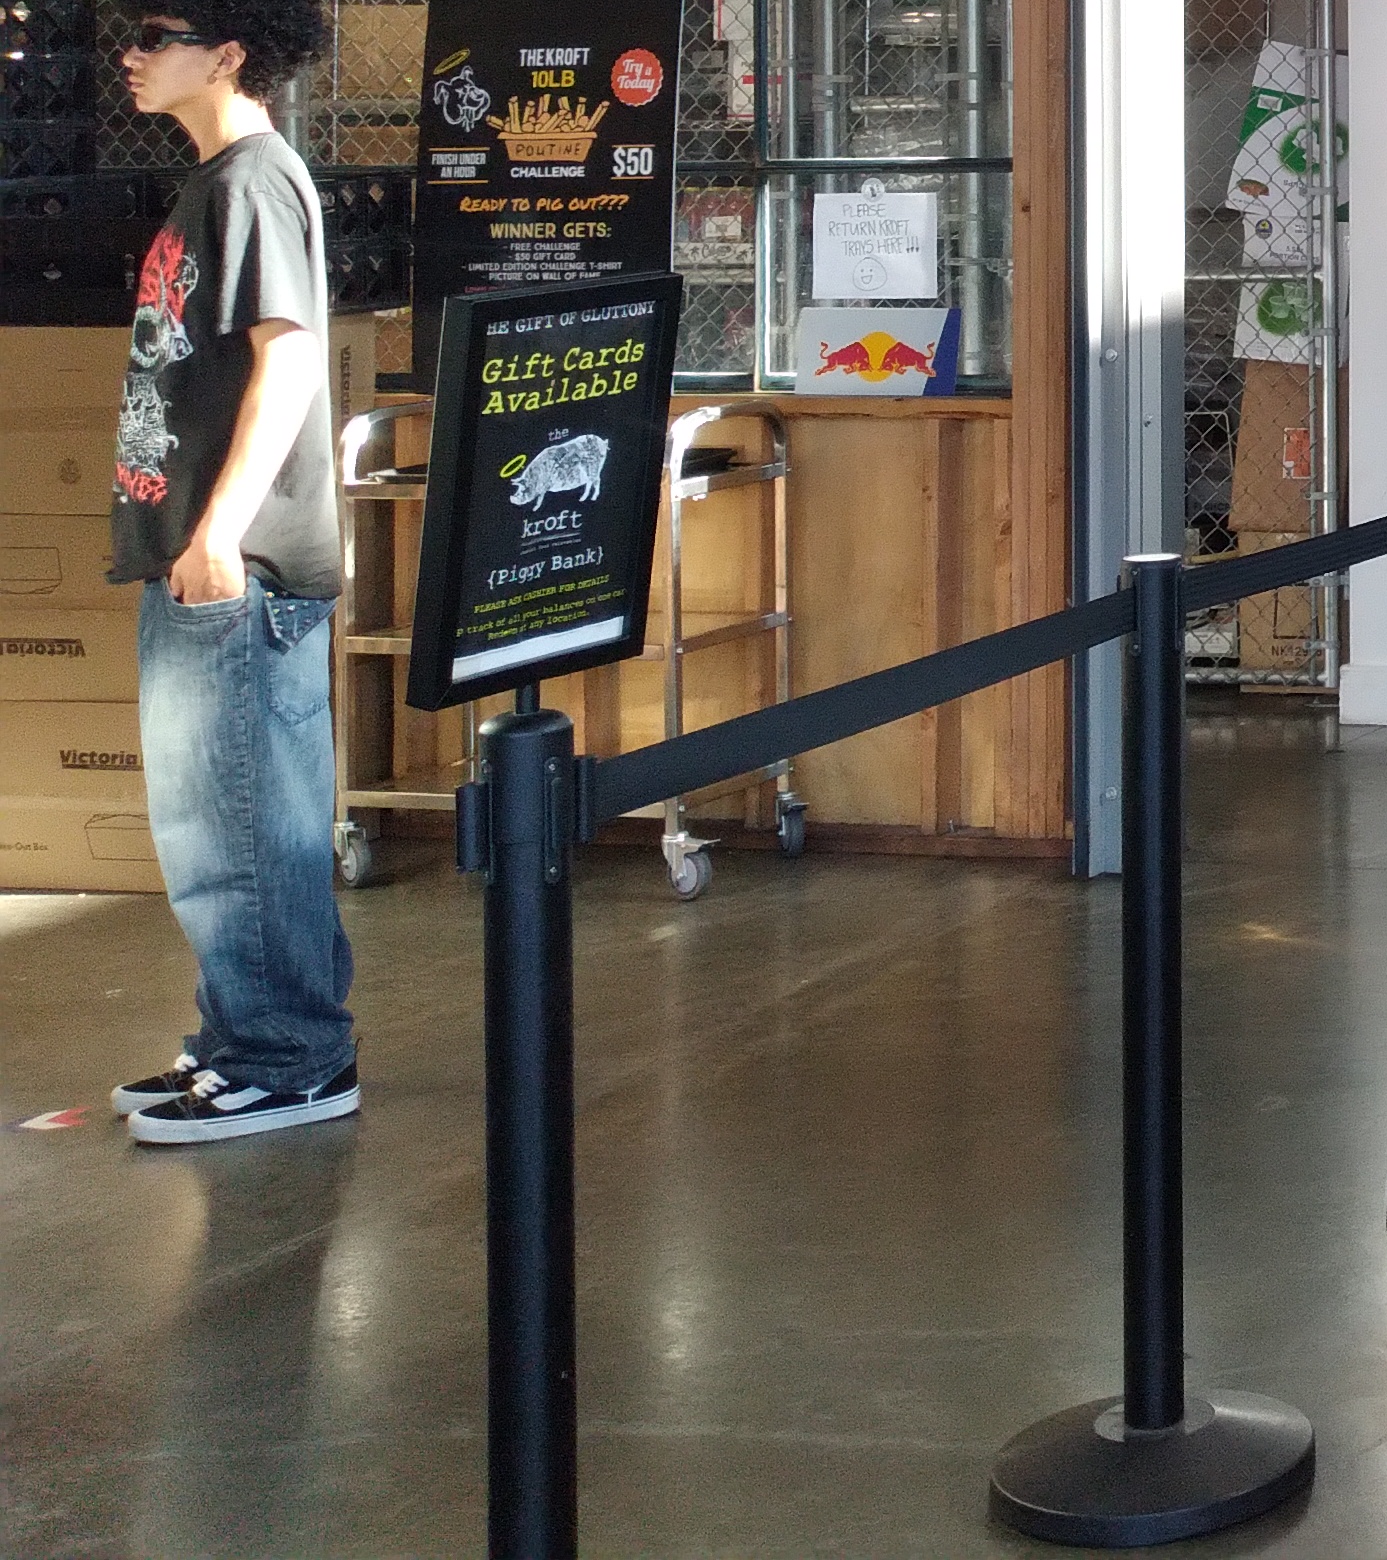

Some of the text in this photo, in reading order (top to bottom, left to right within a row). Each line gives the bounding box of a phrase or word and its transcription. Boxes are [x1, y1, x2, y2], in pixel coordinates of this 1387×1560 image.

[623, 58, 644, 76] Try
[531, 70, 575, 88] 10LB
[617, 75, 655, 91] Today
[515, 143, 581, 157] POUTINE
[432, 153, 486, 165] FINISH UNDER
[613, 147, 653, 178] $50
[441, 167, 476, 178] AN HOUR
[511, 167, 585, 178] CHALLENGE
[460, 195, 630, 211] READY TO PIG OUT???
[842, 203, 887, 218] PLEASE
[490, 222, 612, 239] WINNER GETS:
[828, 219, 910, 237] RETURN KROFT
[510, 243, 581, 251] FREE CHALLENGE
[841, 239, 875, 255] TRAYS
[877, 238, 904, 254] HERE
[515, 252, 576, 261] $50 GIFT CARD
[468, 262, 622, 271] LIMITED EDITION CHALLENGE T-SHIRT
[489, 273, 523, 281] PICTURE
[542, 272, 561, 280] WALL
[564, 272, 576, 280] OF
[515, 314, 555, 333] GIFT
[560, 312, 578, 327] OF
[581, 301, 656, 323] GLUTTONY
[482, 338, 646, 384] Gift Cards
[482, 370, 638, 414] Available
[548, 427, 569, 442] the
[522, 510, 582, 539] kroft
[487, 561, 546, 589] {Piggy
[551, 546, 604, 571] Bank}
[474, 597, 507, 613] PLEASE
[467, 621, 494, 634] track
[496, 617, 506, 627] of
[508, 613, 521, 625] all
[522, 608, 540, 622] your
[543, 599, 584, 616] balances
[5, 639, 85, 657] Victoria
[59, 749, 138, 765] Victoria
